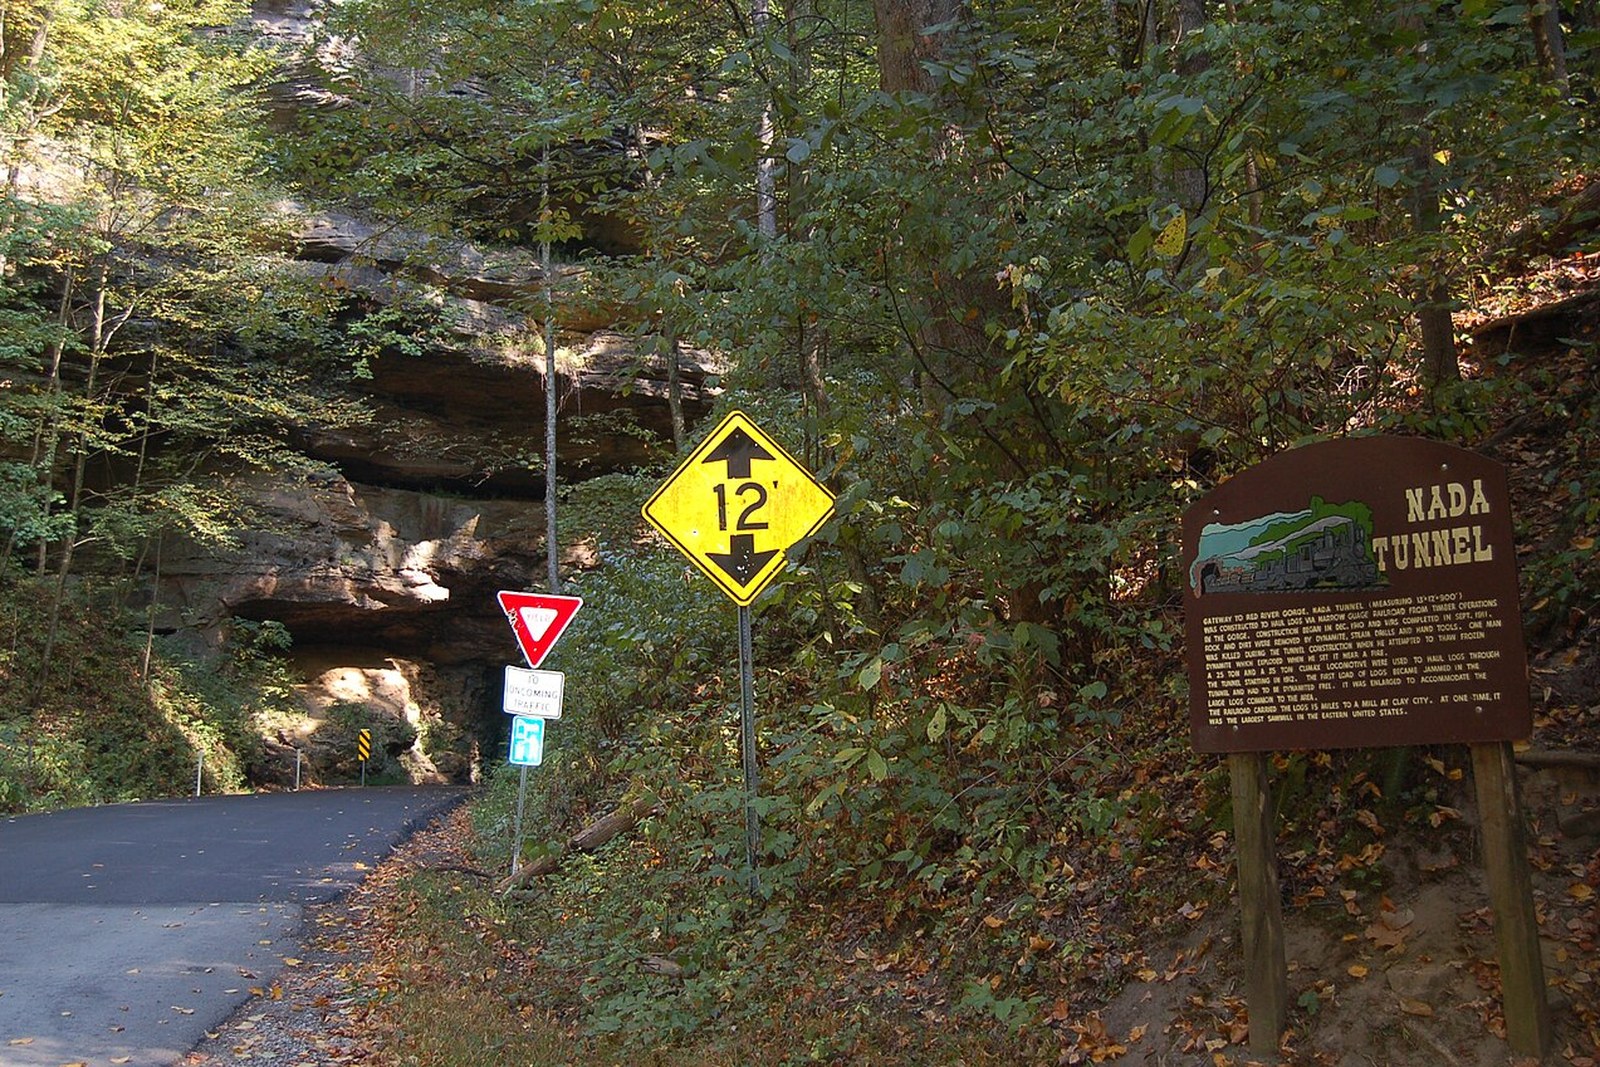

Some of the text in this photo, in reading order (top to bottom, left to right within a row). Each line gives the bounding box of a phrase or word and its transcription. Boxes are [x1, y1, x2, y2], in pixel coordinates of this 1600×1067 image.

[1405, 479, 1490, 522] NADA
[1372, 525, 1493, 571] TUNNEL
[1202, 615, 1232, 625] GATEWAY
[1234, 613, 1243, 622] TO
[1245, 612, 1259, 621] RED
[1259, 610, 1279, 620] RIVER
[1312, 605, 1331, 614] NADA
[1335, 602, 1363, 611] TUNNEL
[1203, 625, 1217, 634] WAS
[1218, 621, 1259, 632] CONSTRUCTED
[1260, 620, 1269, 628] TO
[1270, 619, 1285, 627] HAUL
[1287, 616, 1302, 626] LOGS
[1304, 616, 1315, 624] VIA
[1317, 612, 1345, 622] NARROW
[1372, 607, 1405, 617] RAILROAD
[1408, 605, 1428, 614] FROM
[1431, 602, 1455, 612] TIMBER
[1458, 598, 1497, 610] OPERATIONS
[1203, 635, 1211, 643] IN
[1213, 634, 1224, 642] THE
[1255, 626, 1299, 638] CONSTRUCTION
[1302, 624, 1321, 634] BEGAN
[1367, 619, 1381, 628] AND
[1384, 617, 1398, 626] WAS
[1401, 614, 1439, 624] COMPLETED
[1443, 613, 1451, 621] IN
[1204, 643, 1220, 652] ROCK
[1223, 642, 1236, 650] AND
[1238, 640, 1252, 649] DIRT
[1253, 639, 1270, 648] WERE
[1273, 636, 1300, 646] REMOVED
[1303, 635, 1312, 643] BY
[1350, 630, 1370, 639] STEAM
[1374, 627, 1395, 637] DRILLS
[1398, 626, 1412, 634] AND
[1415, 624, 1433, 633] HAND
[1436, 622, 1462, 632] TOOLS.
[1468, 620, 1482, 629] ONE
[1486, 619, 1501, 628] MAN
[1205, 631, 1484, 661] WAS KILLED DURING THE TUNNEL CONSTRUCTION WHEN HE ATTEMPTED TO THAW FROZEN
[1205, 661, 1231, 670] DYNAMITE
[1235, 659, 1253, 667] WHICH
[1257, 657, 1283, 666] EXPLODED
[1286, 655, 1304, 663] WHEN
[1307, 654, 1315, 662] HE
[1318, 653, 1328, 661] SET
[1342, 650, 1359, 659] NEAR
[1370, 648, 1387, 657] FIRE.
[1206, 671, 1212, 679] A
[1215, 670, 1224, 679] 25
[1227, 669, 1240, 678] TON
[1243, 668, 1256, 676] AND
[1260, 667, 1265, 675] A
[1280, 665, 1293, 674] TON
[1298, 663, 1320, 672] CLIMAX
[1326, 659, 1367, 670] LOCOMOTIVE
[1371, 658, 1387, 667] WERE
[1392, 656, 1408, 665] USED
[1413, 655, 1422, 664] TO
[1426, 654, 1444, 663] HAUL
[1447, 652, 1465, 661] LOGS
[1469, 649, 1500, 660] THROUGH
[1206, 680, 1218, 688] THE
[1220, 679, 1241, 688] TUNNEL
[1244, 676, 1270, 685] STARTING
[1305, 673, 1316, 681] THE
[1320, 672, 1335, 680] FIRST
[1338, 670, 1354, 679] LOAD
[1357, 669, 1365, 677] OF
[1369, 668, 1387, 677] LOGS
[1392, 666, 1417, 675] BECAME
[1423, 664, 1451, 673] JAMMED
[1466, 662, 1479, 670] THE
[509, 685, 558, 699] ONCOMING
[528, 674, 539, 685] TO
[1207, 689, 1230, 697] TUNNEL
[1232, 688, 1245, 696] AND
[1246, 687, 1259, 695] HAD
[1261, 686, 1270, 694] TO
[1272, 685, 1279, 693] BE
[1282, 683, 1315, 692] DYNAMITED
[1318, 682, 1335, 690] FREE.
[1352, 679, 1366, 687] WAS
[1369, 677, 1401, 686] ENLARGED
[1406, 676, 1415, 684] TO
[1420, 672, 1469, 683] ACCOMMODATE
[1474, 671, 1486, 680] THE
[514, 699, 551, 712] TRAFFIC
[1207, 692, 1317, 707] LARGE LOGS COMMON TO THE AREA.
[1208, 708, 1220, 716] THE
[1222, 706, 1251, 716] RAILROAD
[1253, 705, 1277, 714] CARRIED
[1279, 704, 1291, 712] THE
[1292, 703, 1309, 712] LOGS
[1310, 702, 1318, 711] 15
[1320, 701, 1339, 710] MILES
[1342, 700, 1352, 708] TO
[1353, 700, 1359, 708] A
[1361, 699, 1378, 707] MILL
[1379, 698, 1388, 706] AT
[1391, 697, 1409, 706] CLAY
[1412, 695, 1432, 704] CITY.
[1452, 693, 1468, 702] ONE
[1493, 692, 1500, 700] IT
[1208, 717, 1223, 725] WAS
[1226, 716, 1237, 724] THE
[1240, 715, 1264, 724] LARGEST
[1306, 712, 1318, 720] THE
[1321, 710, 1348, 719] EASTERN
[1351, 709, 1376, 718] UNITED
[1378, 707, 1407, 716] STATES.
